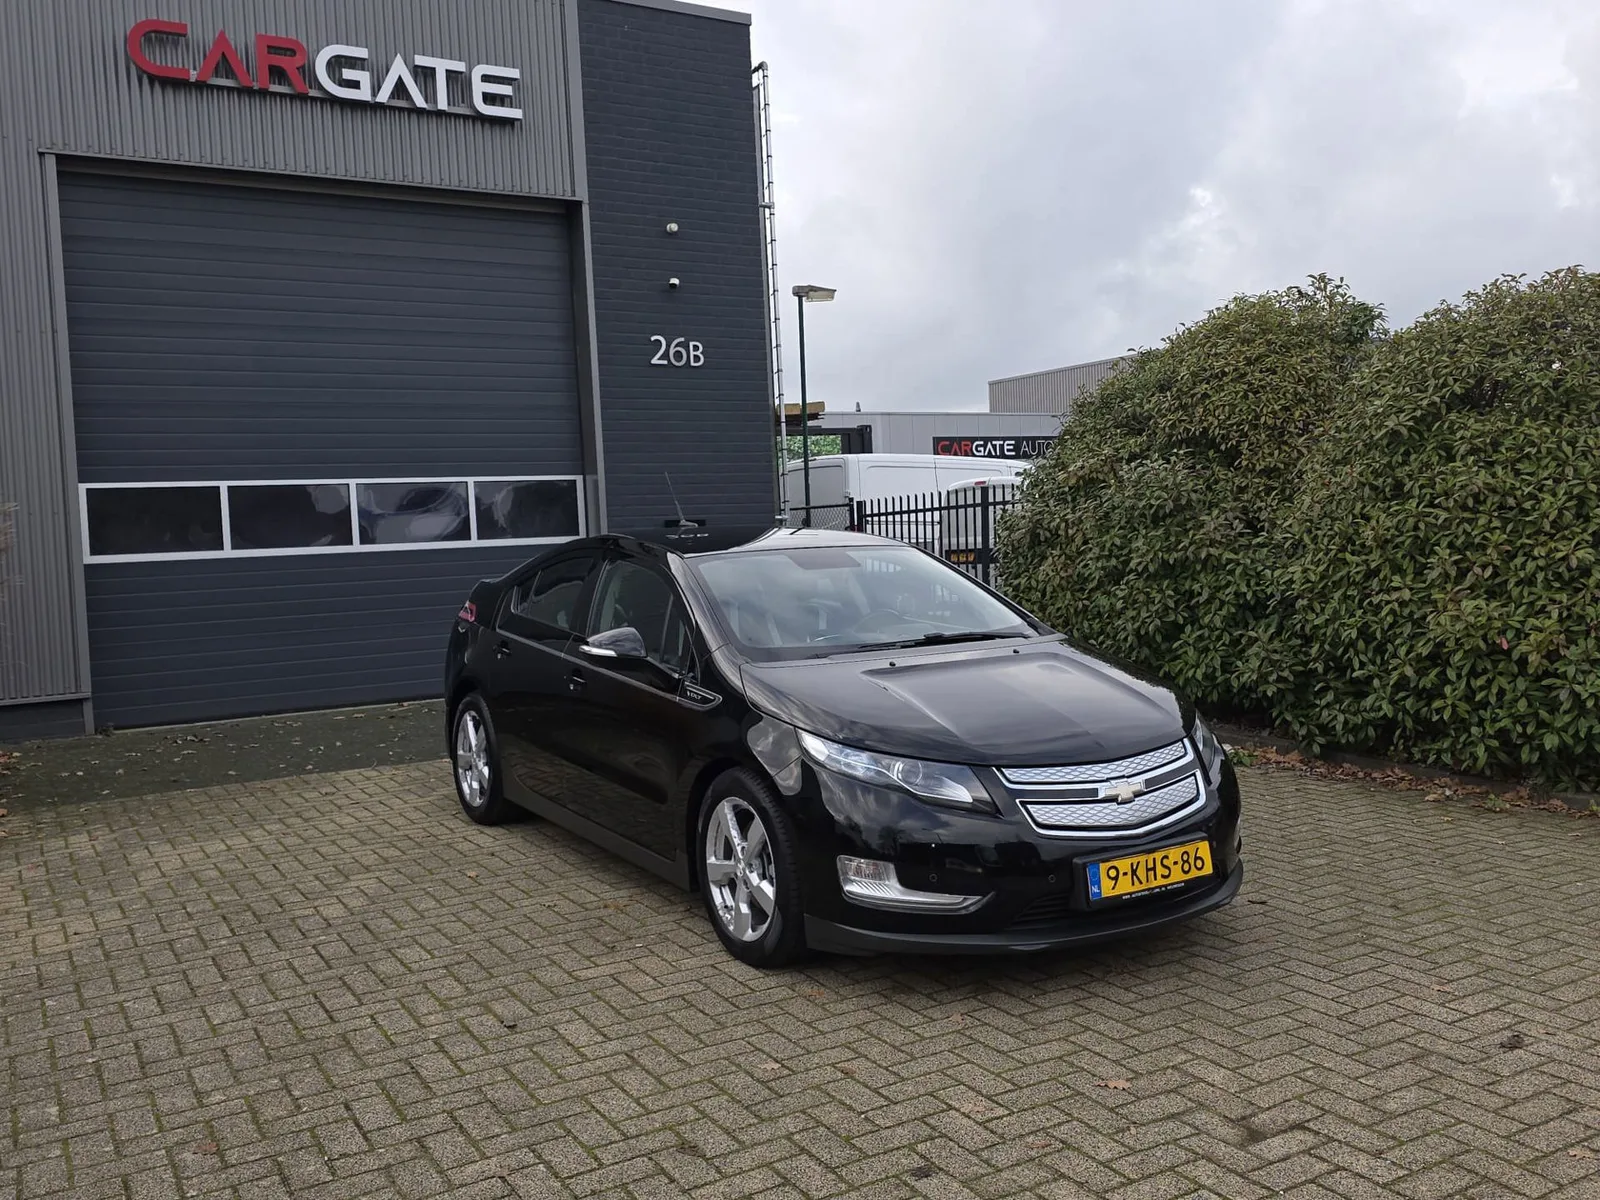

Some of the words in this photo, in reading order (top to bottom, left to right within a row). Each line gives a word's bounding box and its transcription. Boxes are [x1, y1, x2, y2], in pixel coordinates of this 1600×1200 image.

[127, 19, 523, 121] CARGATE
[650, 335, 705, 367] 26B
[937, 440, 1016, 456] CARGATE
[1091, 884, 1101, 894] NL
[1106, 847, 1205, 891] 9-KHS-86
